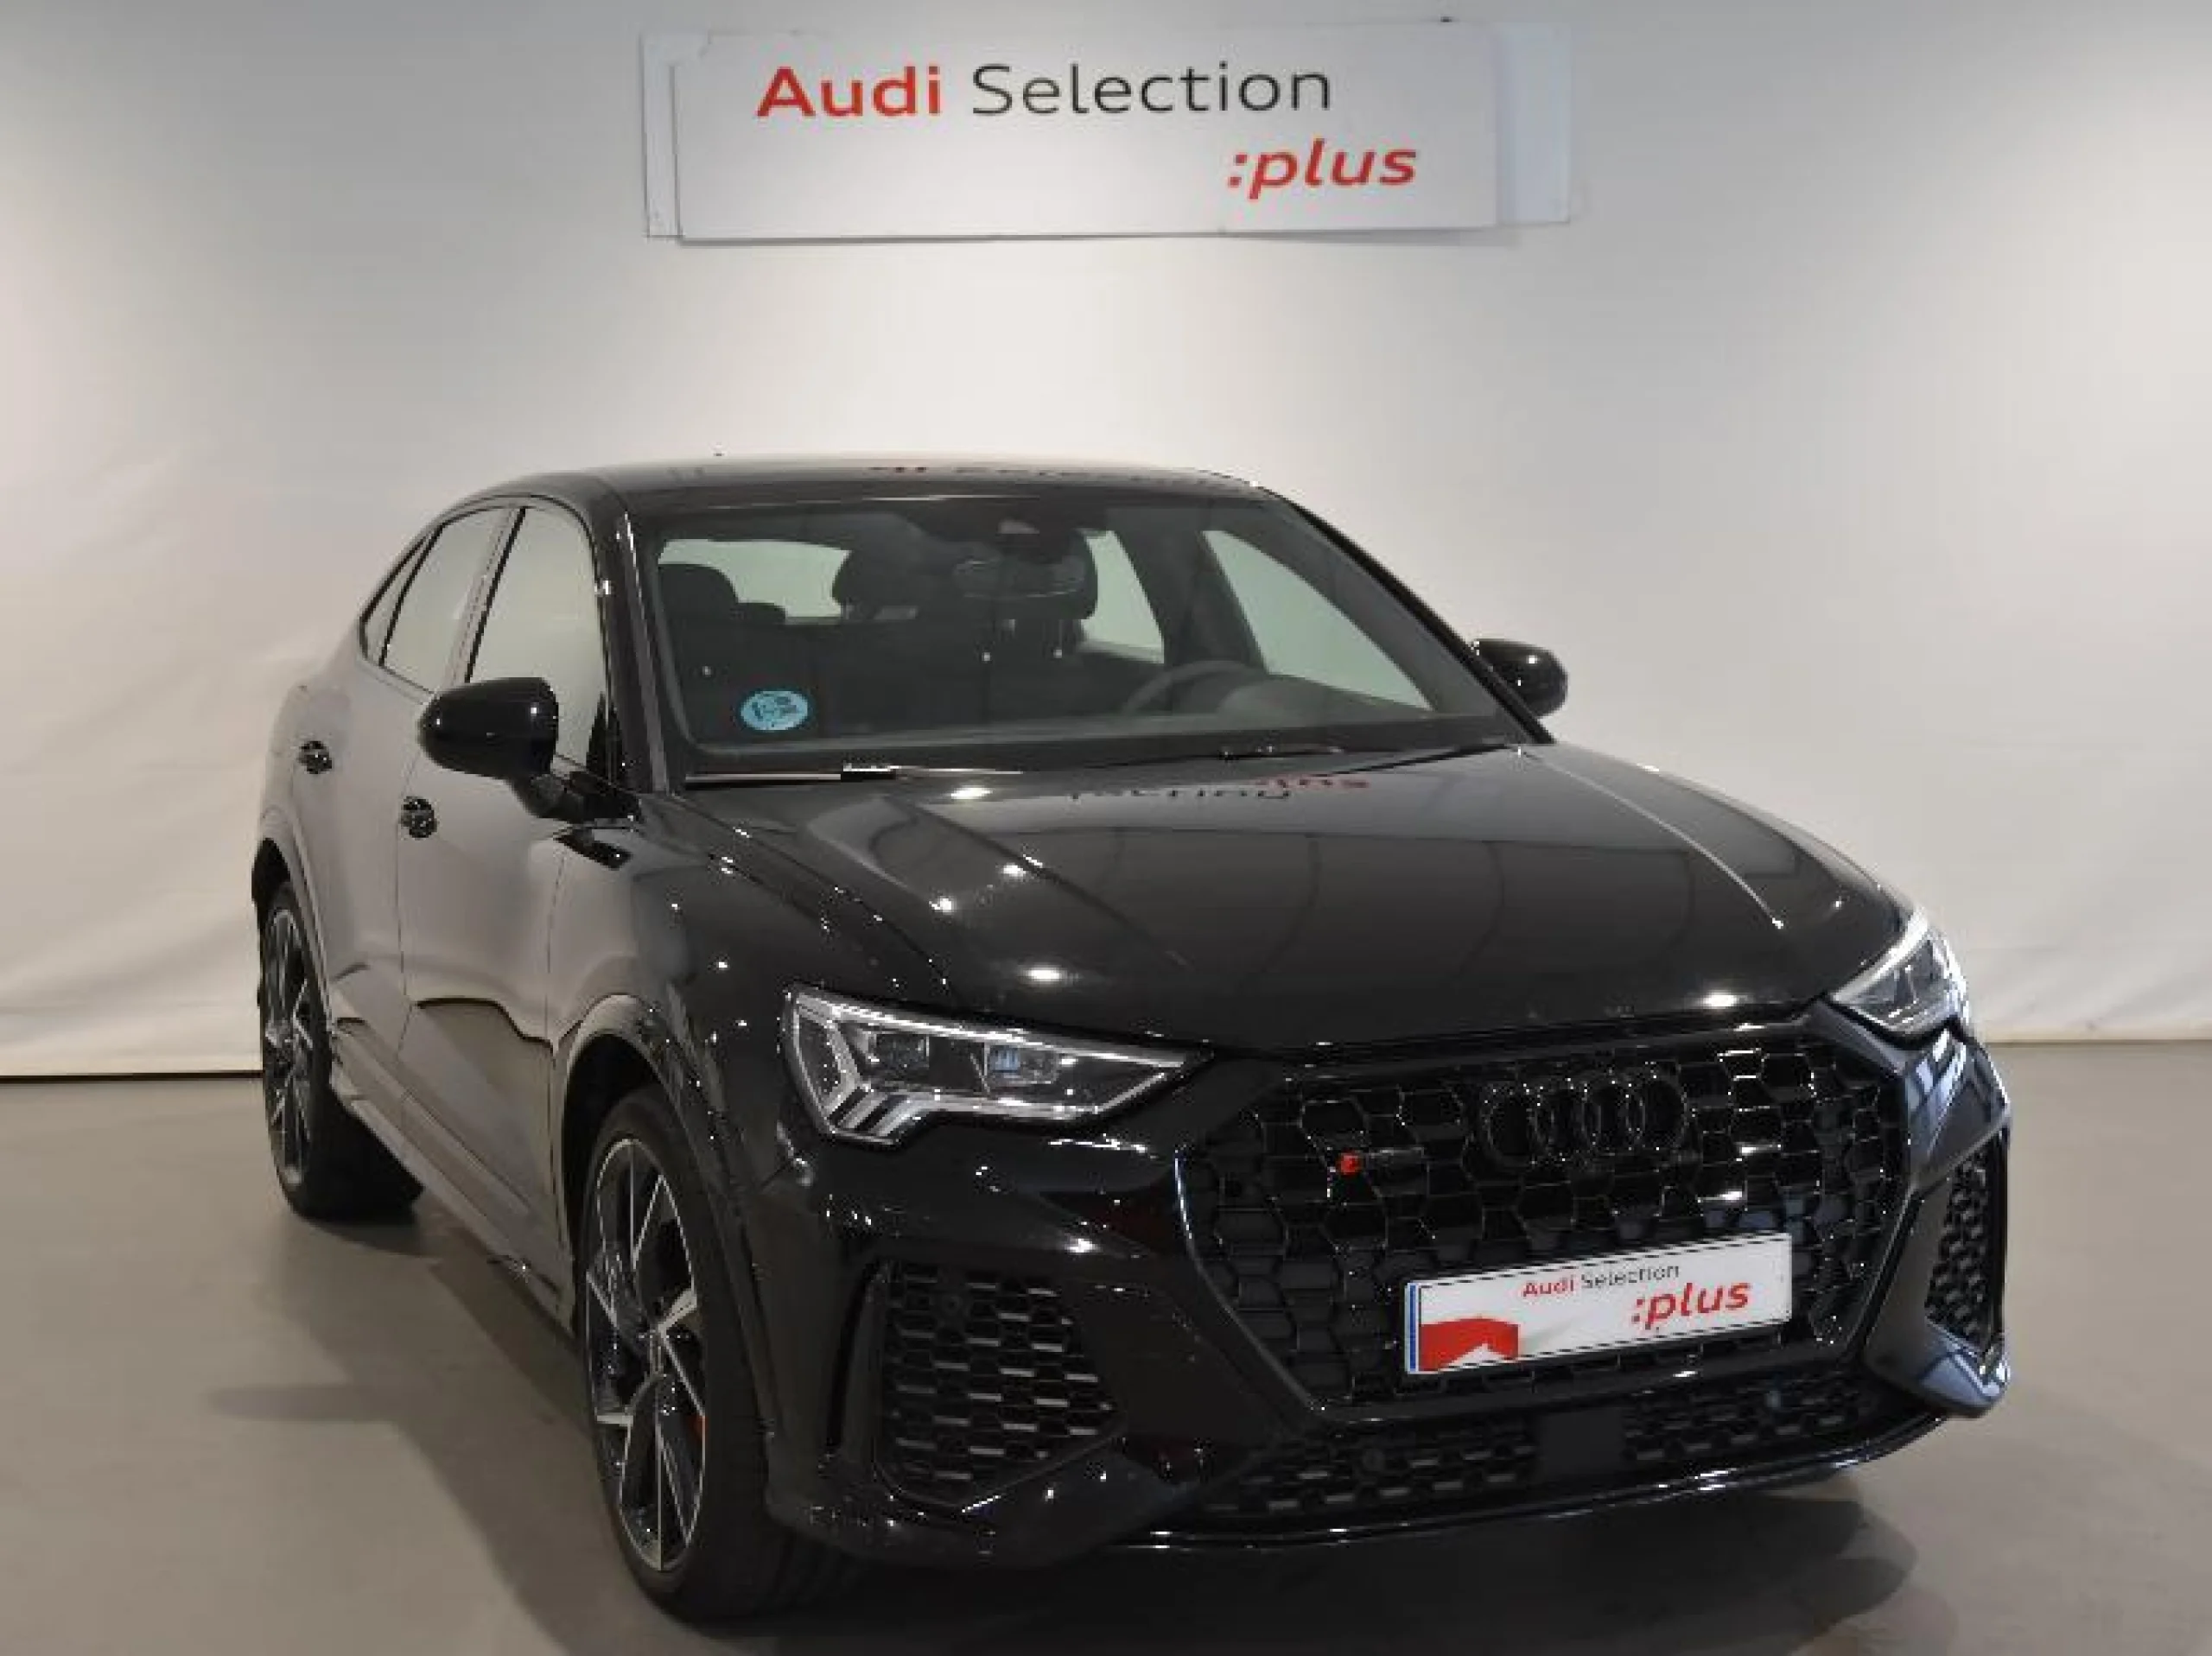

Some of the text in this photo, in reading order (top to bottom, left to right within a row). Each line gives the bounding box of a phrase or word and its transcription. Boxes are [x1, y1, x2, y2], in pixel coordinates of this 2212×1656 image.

[756, 60, 1332, 119] Audi Selection
[1227, 138, 1417, 201] :plus
[1522, 1265, 1679, 1297] Audi Selection
[1631, 1282, 1751, 1329] :plus
